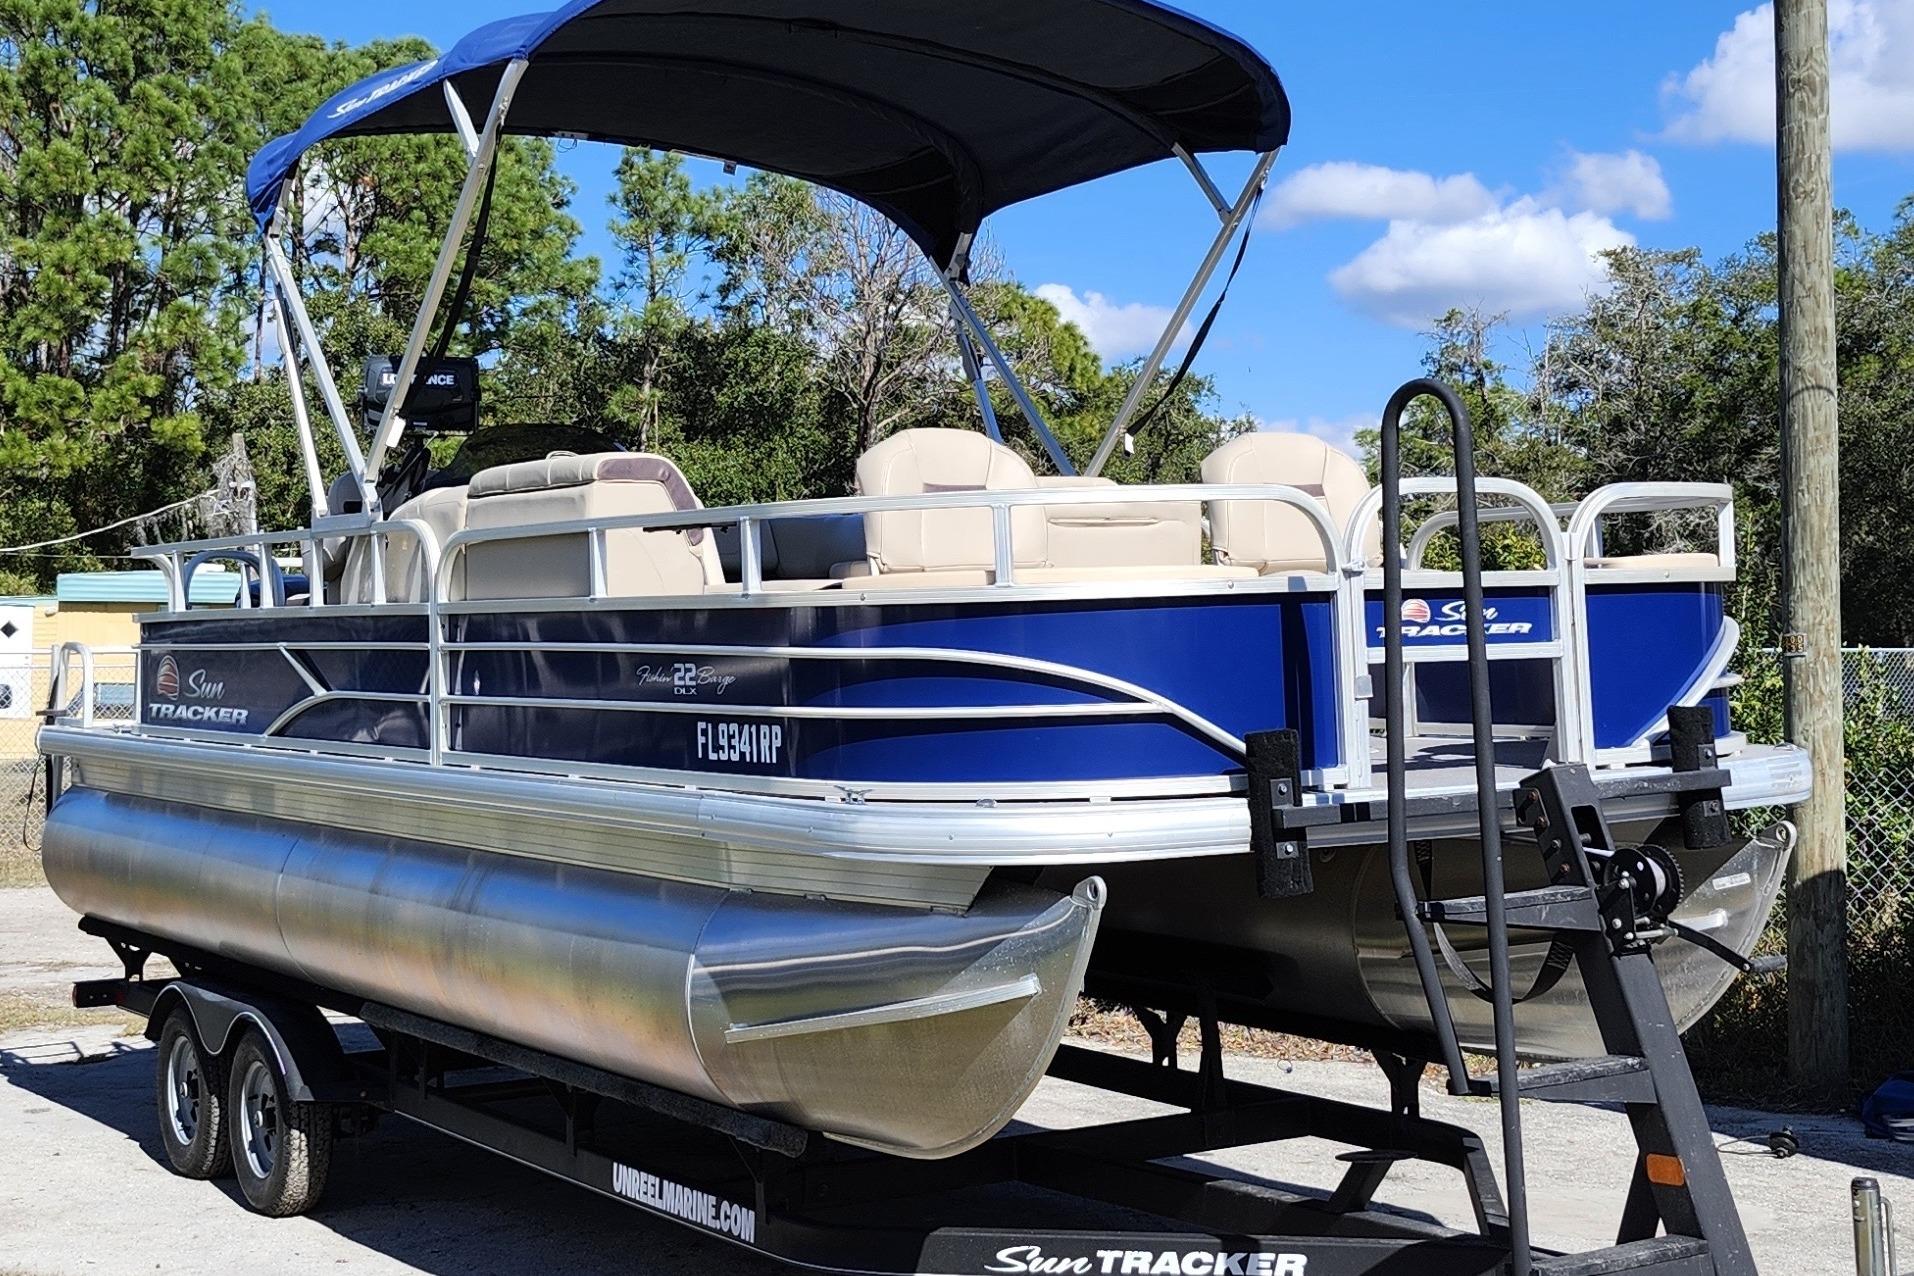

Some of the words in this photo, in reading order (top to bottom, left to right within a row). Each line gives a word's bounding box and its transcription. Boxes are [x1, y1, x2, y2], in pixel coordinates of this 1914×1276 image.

[183, 668, 225, 699] Sun
[673, 663, 697, 686] 22
[697, 666, 736, 695] Barge
[674, 687, 698, 695] DLX
[149, 703, 249, 726] TRACKER
[613, 1161, 756, 1244] UNREELMARINE.COM
[984, 1245, 1092, 1275] Sun
[1096, 1249, 1308, 1276] TRACKER
